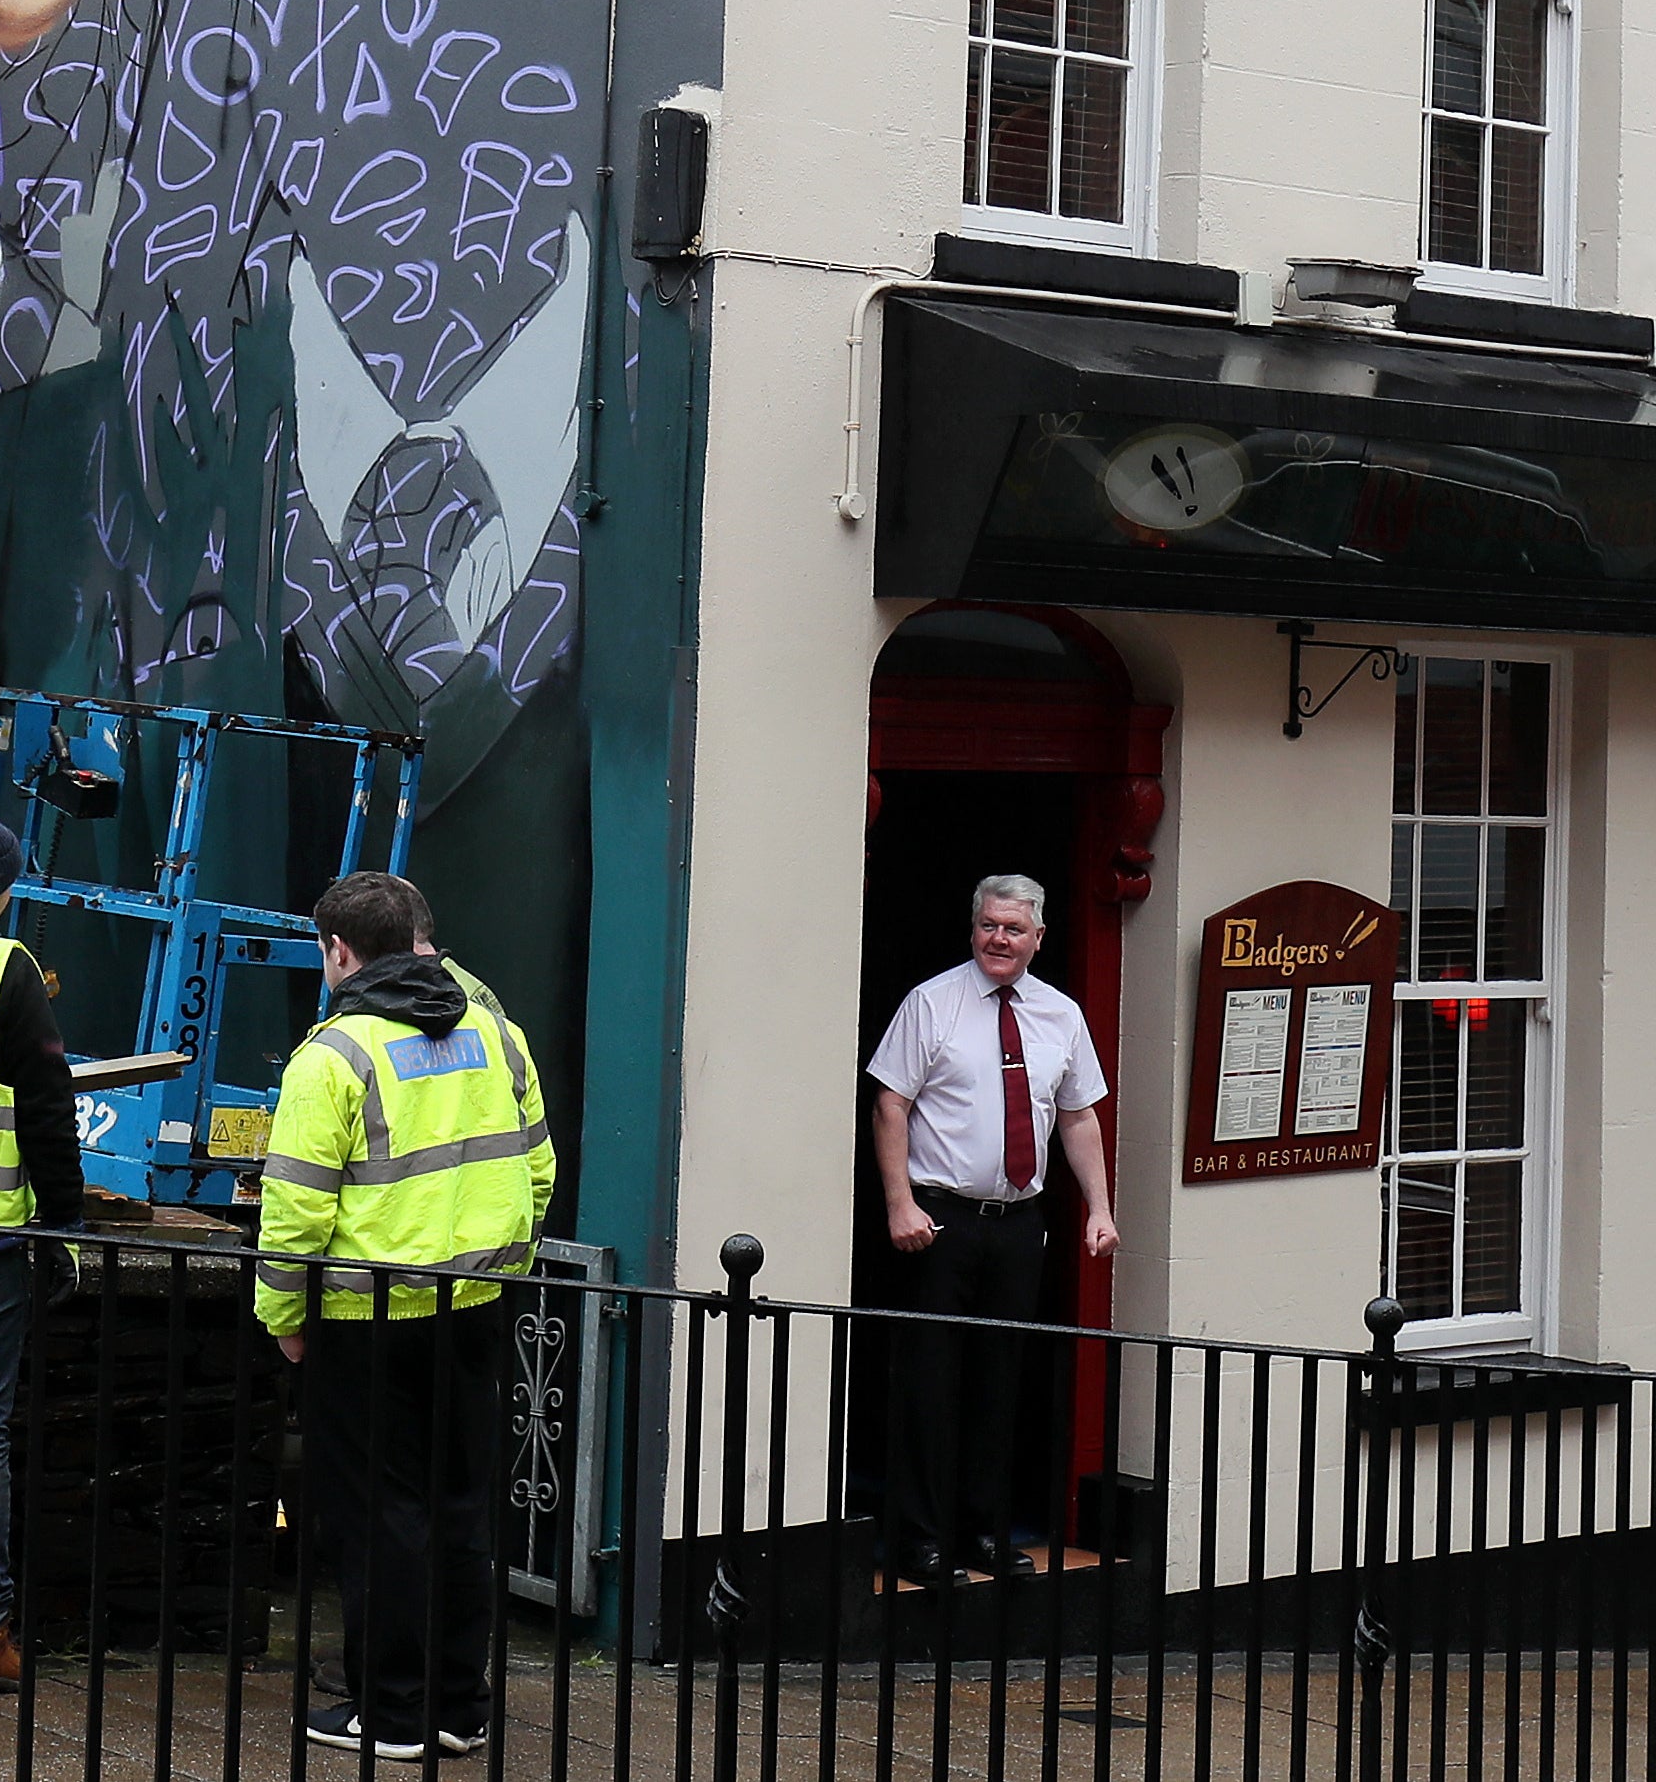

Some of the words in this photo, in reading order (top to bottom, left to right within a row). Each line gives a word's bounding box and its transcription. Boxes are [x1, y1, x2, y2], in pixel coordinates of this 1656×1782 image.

[1221, 919, 1329, 976] Badgers
[1262, 995, 1288, 1010] MENU
[1342, 990, 1367, 1006] MENU
[393, 1036, 480, 1073] SECURITY
[1194, 1154, 1228, 1173] BAR
[1237, 1153, 1247, 1169] &
[1257, 1143, 1373, 1168] RESTAURANT
